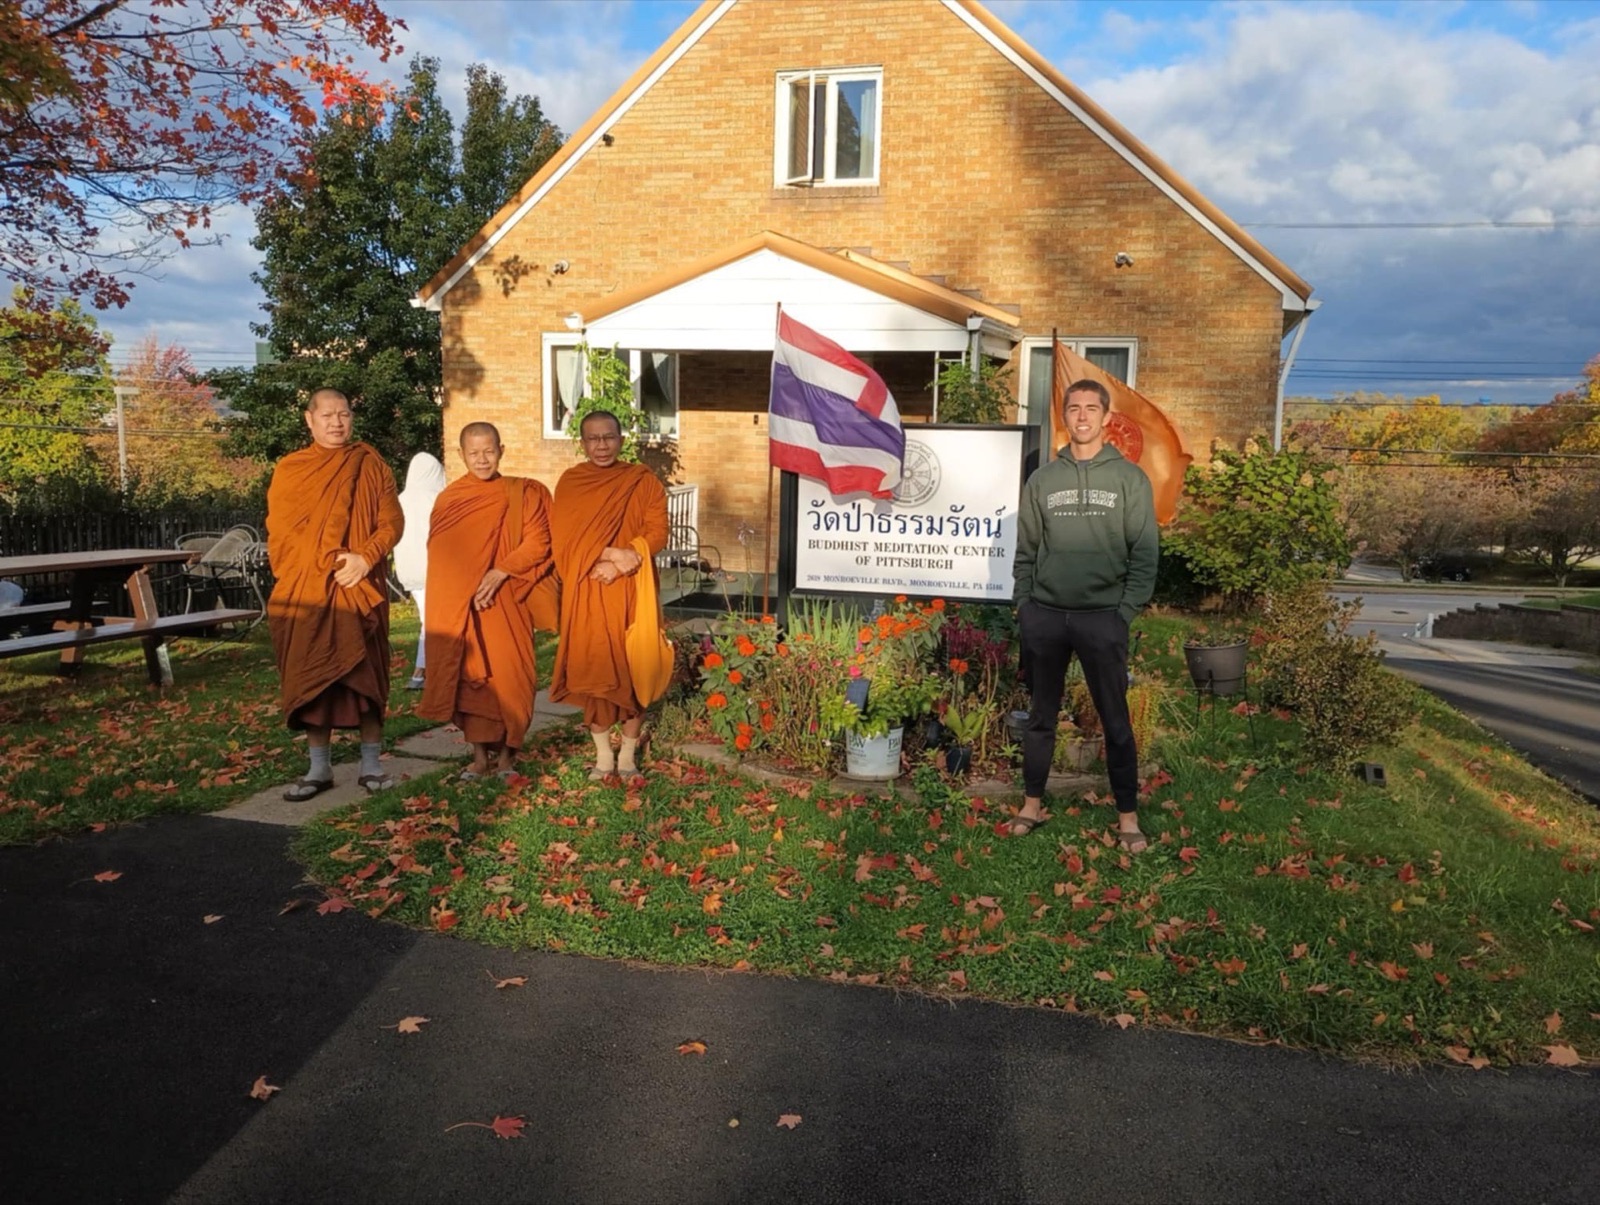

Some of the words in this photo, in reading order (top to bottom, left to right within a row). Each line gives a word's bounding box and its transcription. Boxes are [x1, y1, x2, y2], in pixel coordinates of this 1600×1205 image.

[1083, 489, 1118, 509] PARK
[807, 499, 1006, 538] วัดป่าธรรมรัตน์
[808, 538, 869, 552] BUDDHIST
[873, 542, 949, 556] MEDITATION
[953, 545, 1006, 558] CENTER
[855, 555, 872, 567] OF
[875, 557, 954, 571] PITTSBURGH
[823, 575, 880, 584] MONROEVILLE
[909, 579, 970, 589] MONROEVILLE,
[972, 582, 983, 590] PA
